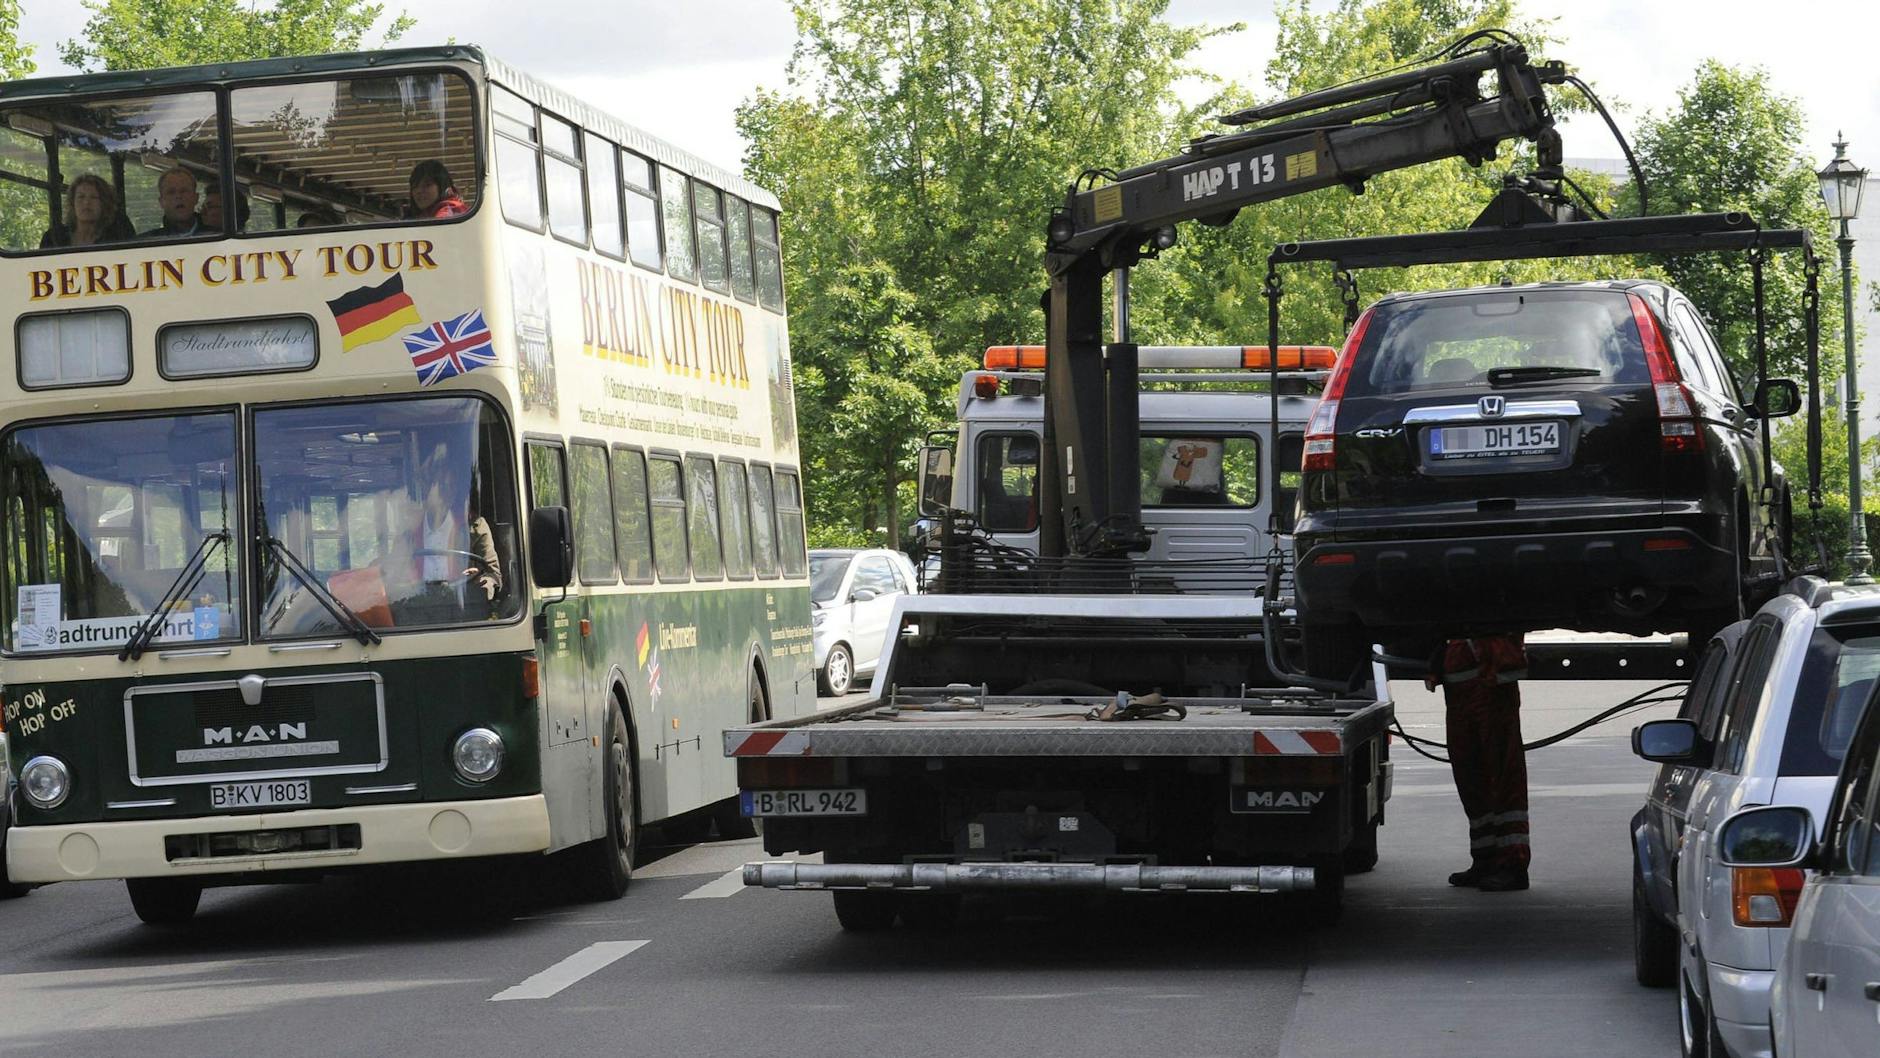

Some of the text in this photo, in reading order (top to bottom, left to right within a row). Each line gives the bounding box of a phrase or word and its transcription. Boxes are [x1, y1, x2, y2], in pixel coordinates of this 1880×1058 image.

[1227, 163, 1242, 191] T
[1249, 153, 1275, 185] 13
[28, 239, 439, 300] BERLIN CITY TOUR
[576, 257, 750, 390] BERLIN CITY TOUR
[171, 328, 312, 353] Stadtrundfahrt
[1485, 426, 1513, 448] DH
[1517, 425, 1556, 446] 154
[59, 619, 194, 643] adtrundhrt
[3, 688, 46, 723] HOP ON
[19, 698, 76, 737] HOP OFF
[212, 780, 309, 806] B KV 1803
[761, 793, 774, 812] B
[788, 793, 814, 812] RL
[819, 792, 857, 812] 942
[1247, 791, 1324, 807] MAN
